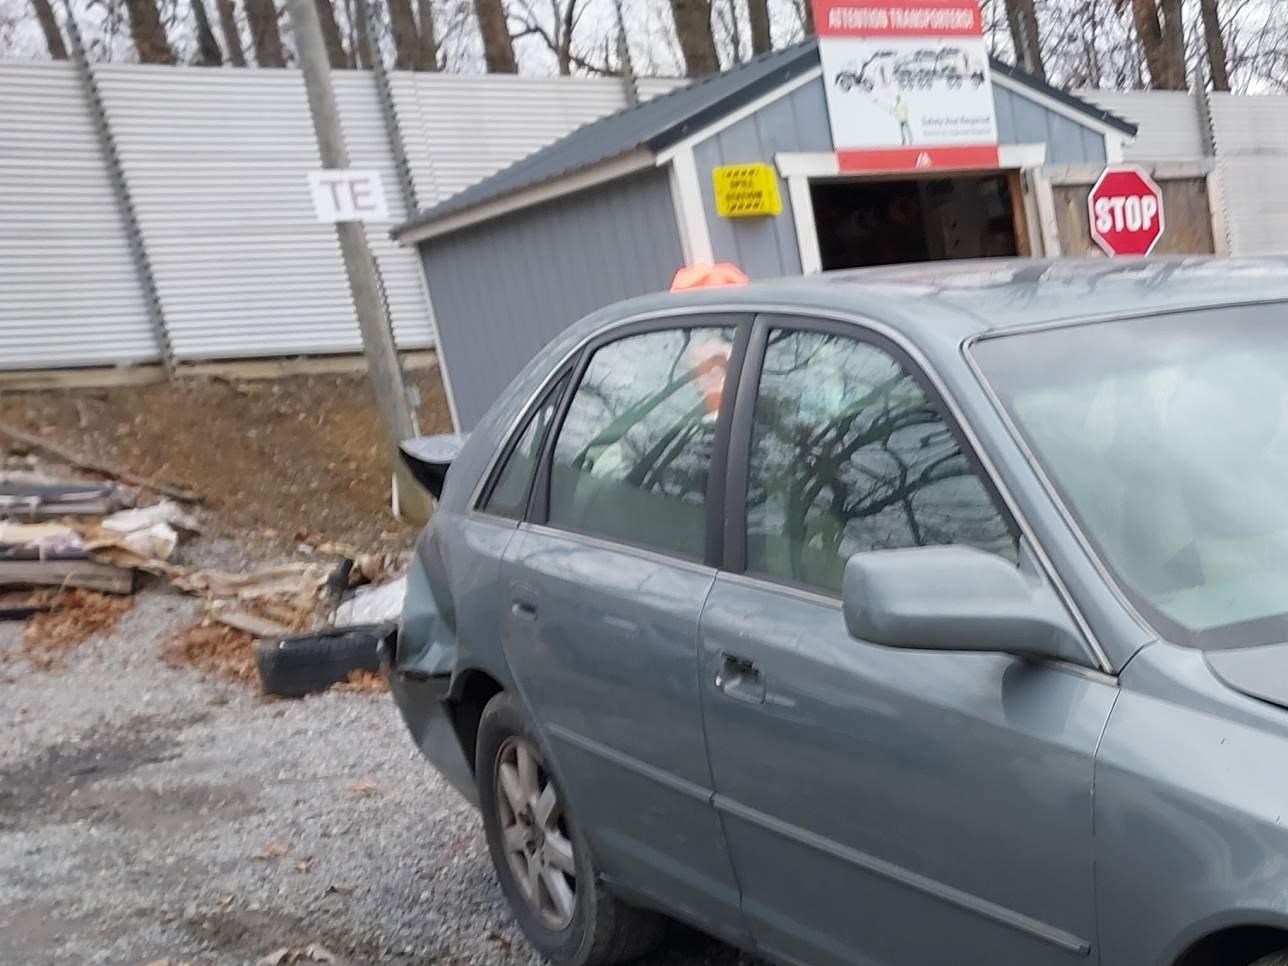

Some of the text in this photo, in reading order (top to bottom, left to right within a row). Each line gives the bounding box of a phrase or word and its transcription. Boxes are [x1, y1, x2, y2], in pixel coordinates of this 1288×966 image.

[829, 7, 888, 29] ATTENTION
[319, 179, 377, 212] TE
[1095, 195, 1157, 233] STOP
